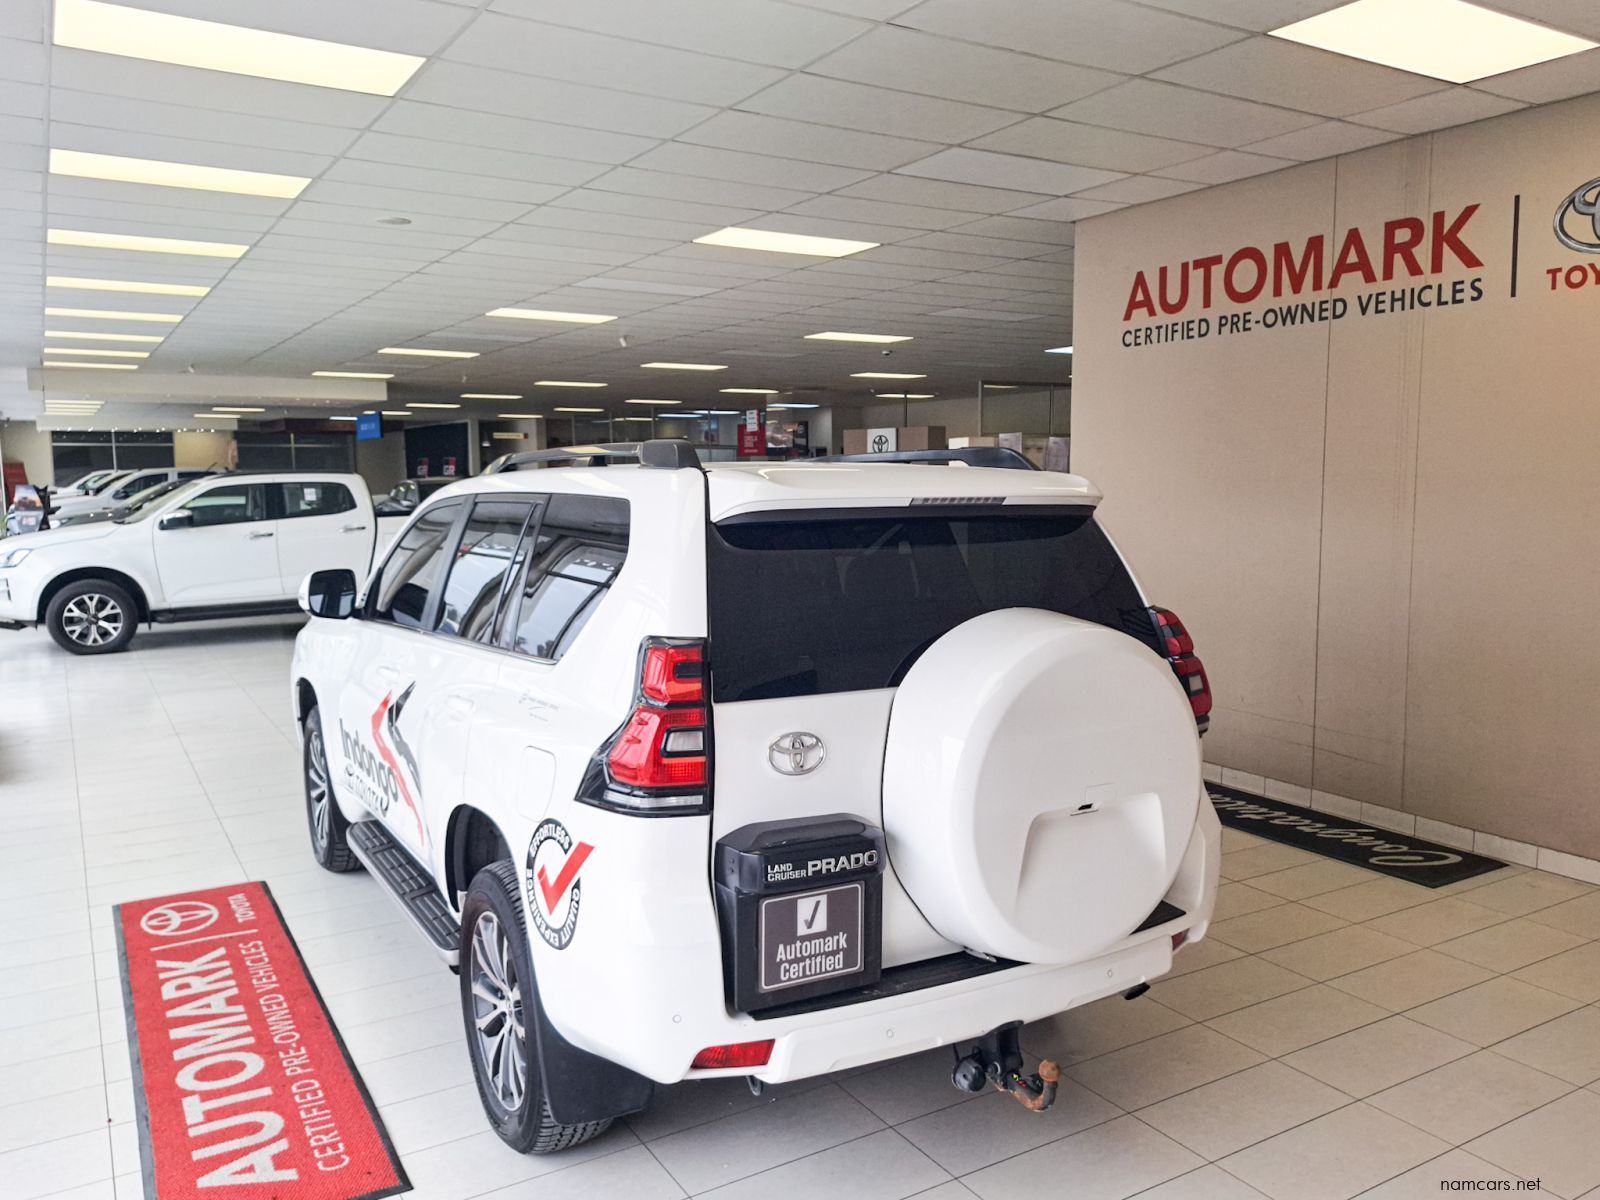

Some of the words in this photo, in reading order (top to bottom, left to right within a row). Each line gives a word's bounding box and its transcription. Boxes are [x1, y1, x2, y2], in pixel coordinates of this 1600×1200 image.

[1122, 203, 1485, 321] AUTOMARK
[1121, 317, 1210, 347] CERTIFIED
[1217, 297, 1348, 336] PRE-OWNED
[1357, 277, 1485, 316] VEHICLES
[443, 465, 456, 476] GR
[530, 823, 570, 858] EFFORTLESS
[767, 863, 793, 874] LAND
[807, 850, 878, 876] PRADO
[767, 869, 807, 882] CRUISER
[228, 893, 257, 923] TOYOTA
[526, 868, 560, 947] EXPERIENCE
[560, 888, 581, 945] QUALITY
[239, 940, 280, 998] VEHICLES
[776, 931, 848, 963] Automark
[780, 951, 844, 982] Certified
[259, 993, 312, 1077] PRE-OWNED
[156, 946, 299, 1189] AUTOMARK
[291, 1067, 350, 1172] CERTIFIED
